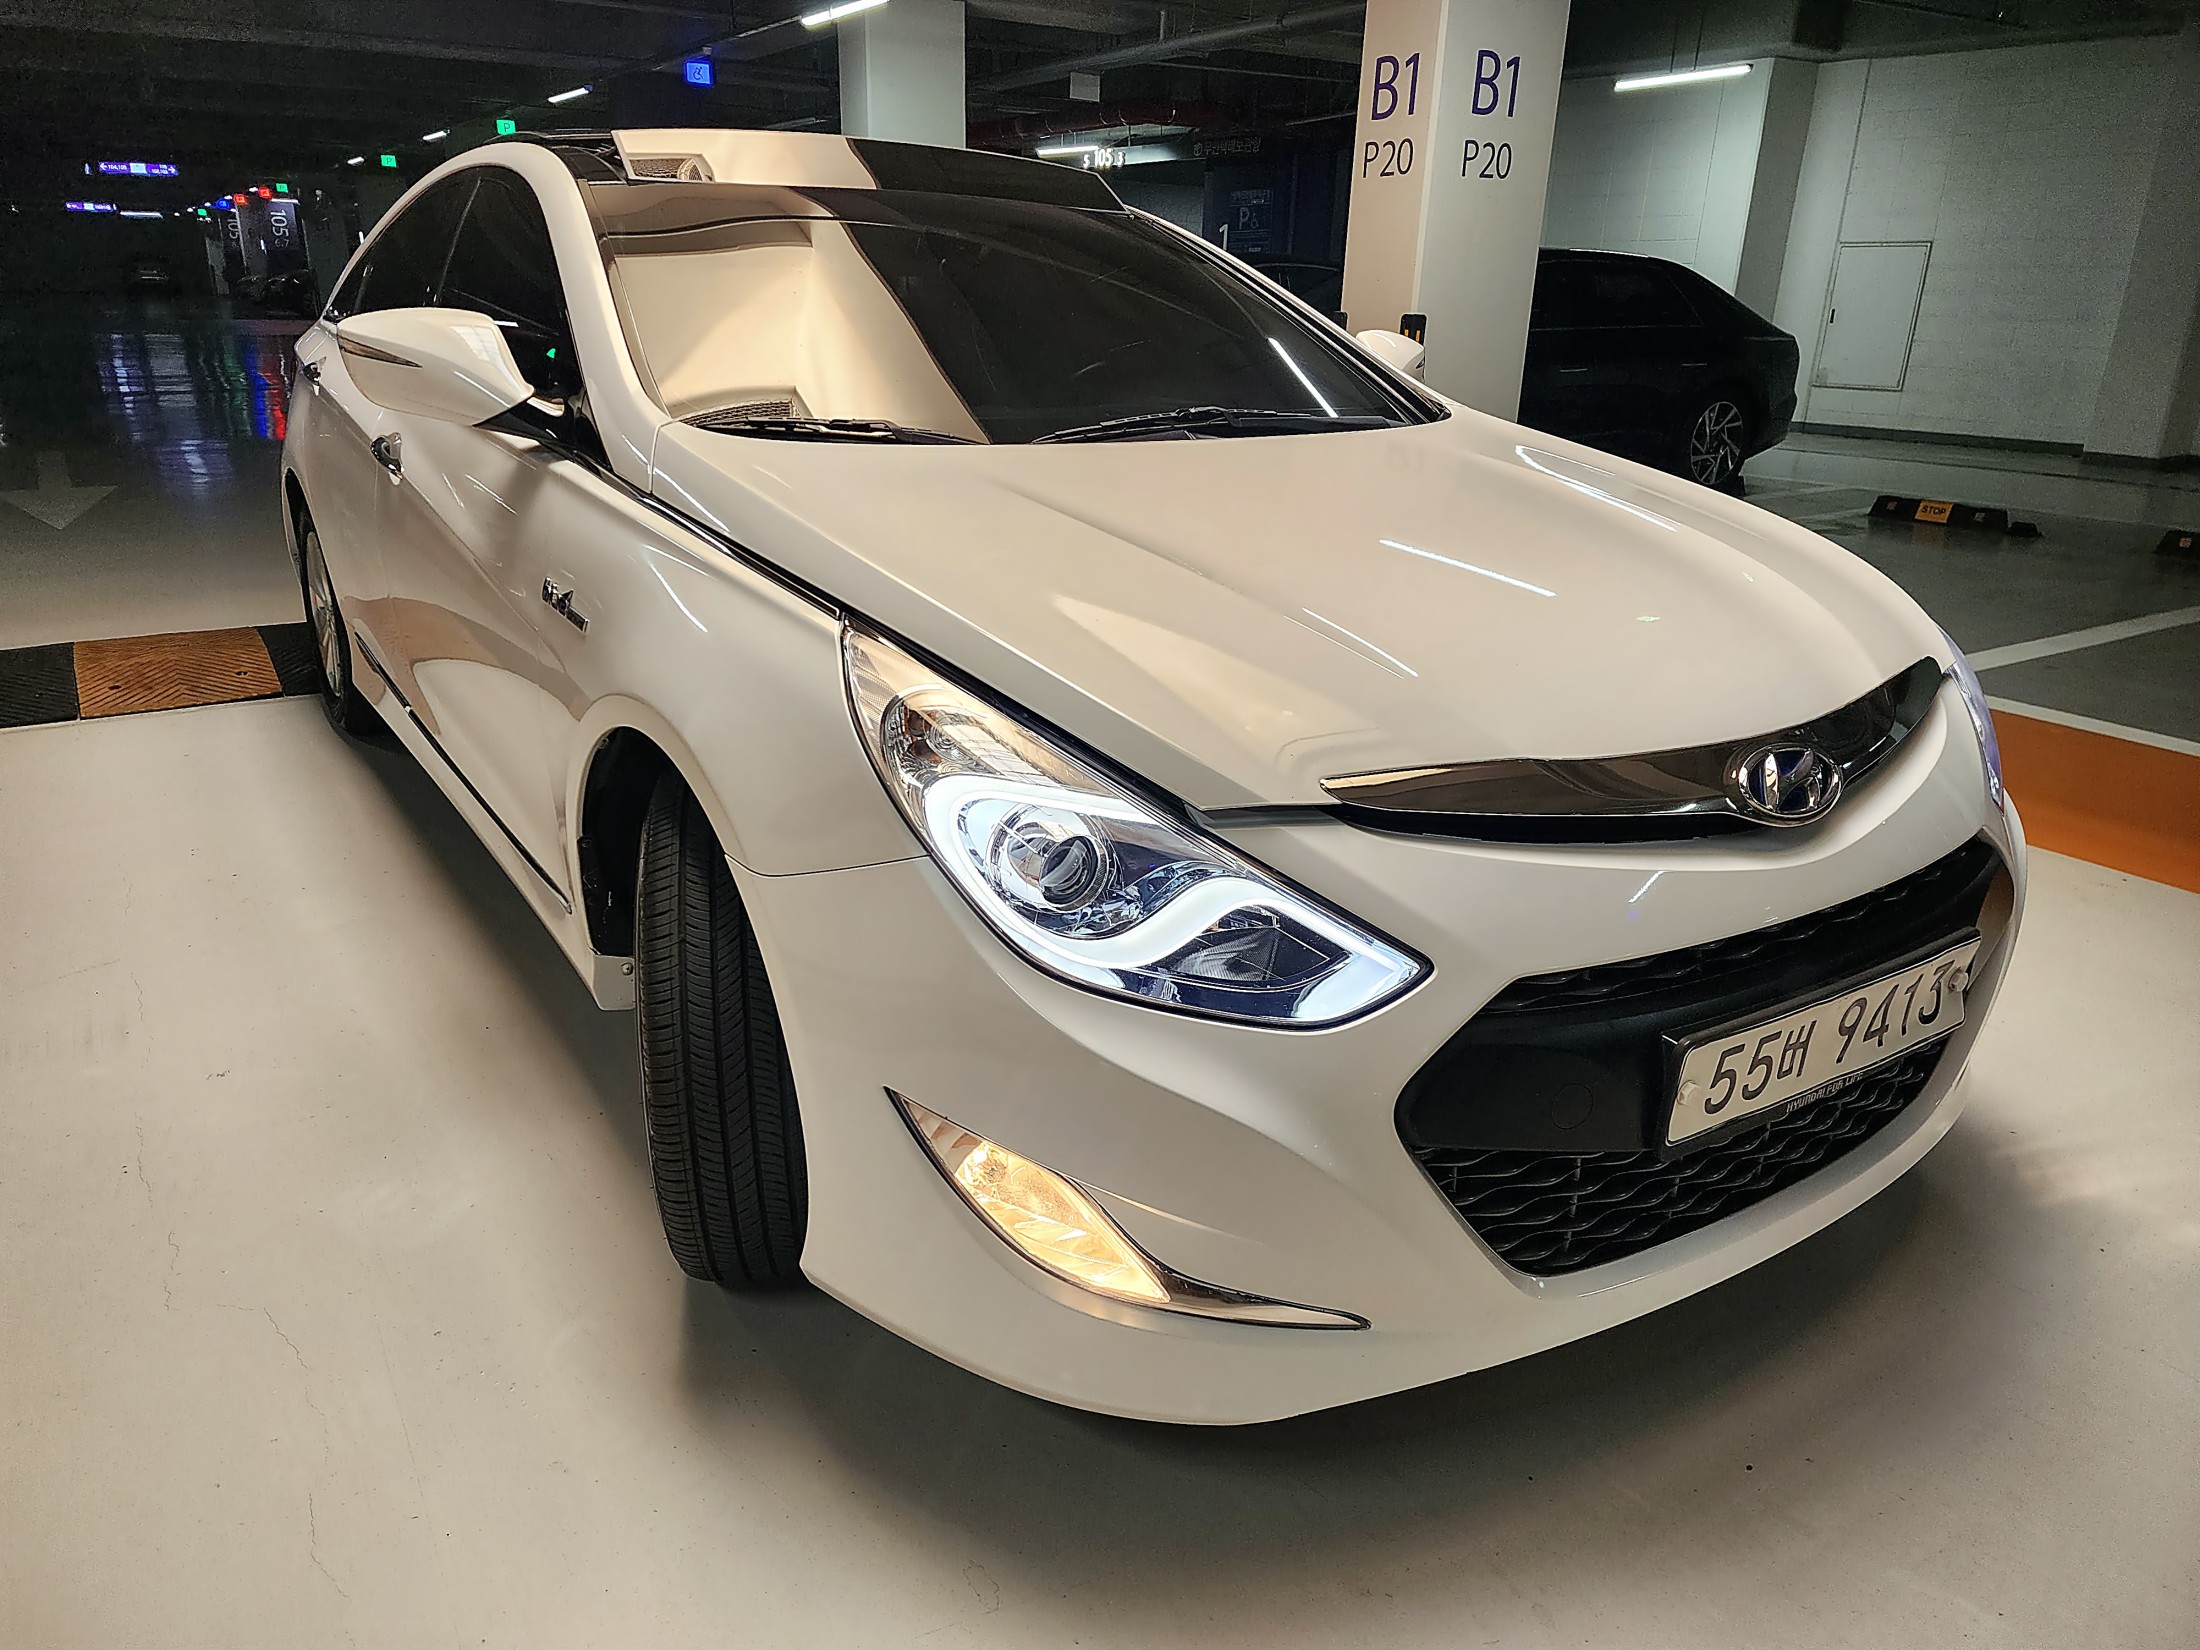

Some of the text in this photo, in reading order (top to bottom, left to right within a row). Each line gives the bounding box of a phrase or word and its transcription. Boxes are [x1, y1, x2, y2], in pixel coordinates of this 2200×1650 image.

[1371, 52, 1420, 120] B1
[1471, 50, 1520, 118] B1
[1094, 148, 1112, 168] 105
[1117, 152, 1124, 167] 3
[1363, 138, 1414, 178] P20
[1462, 139, 1512, 179] P20
[270, 209, 290, 237] 105
[1240, 207, 1250, 230] P
[1922, 505, 1947, 515] STOP
[1704, 960, 1955, 1115] 55버 9413
[1786, 1088, 1826, 1113] HYUNDAI
[1826, 1080, 1844, 1095] FOR
